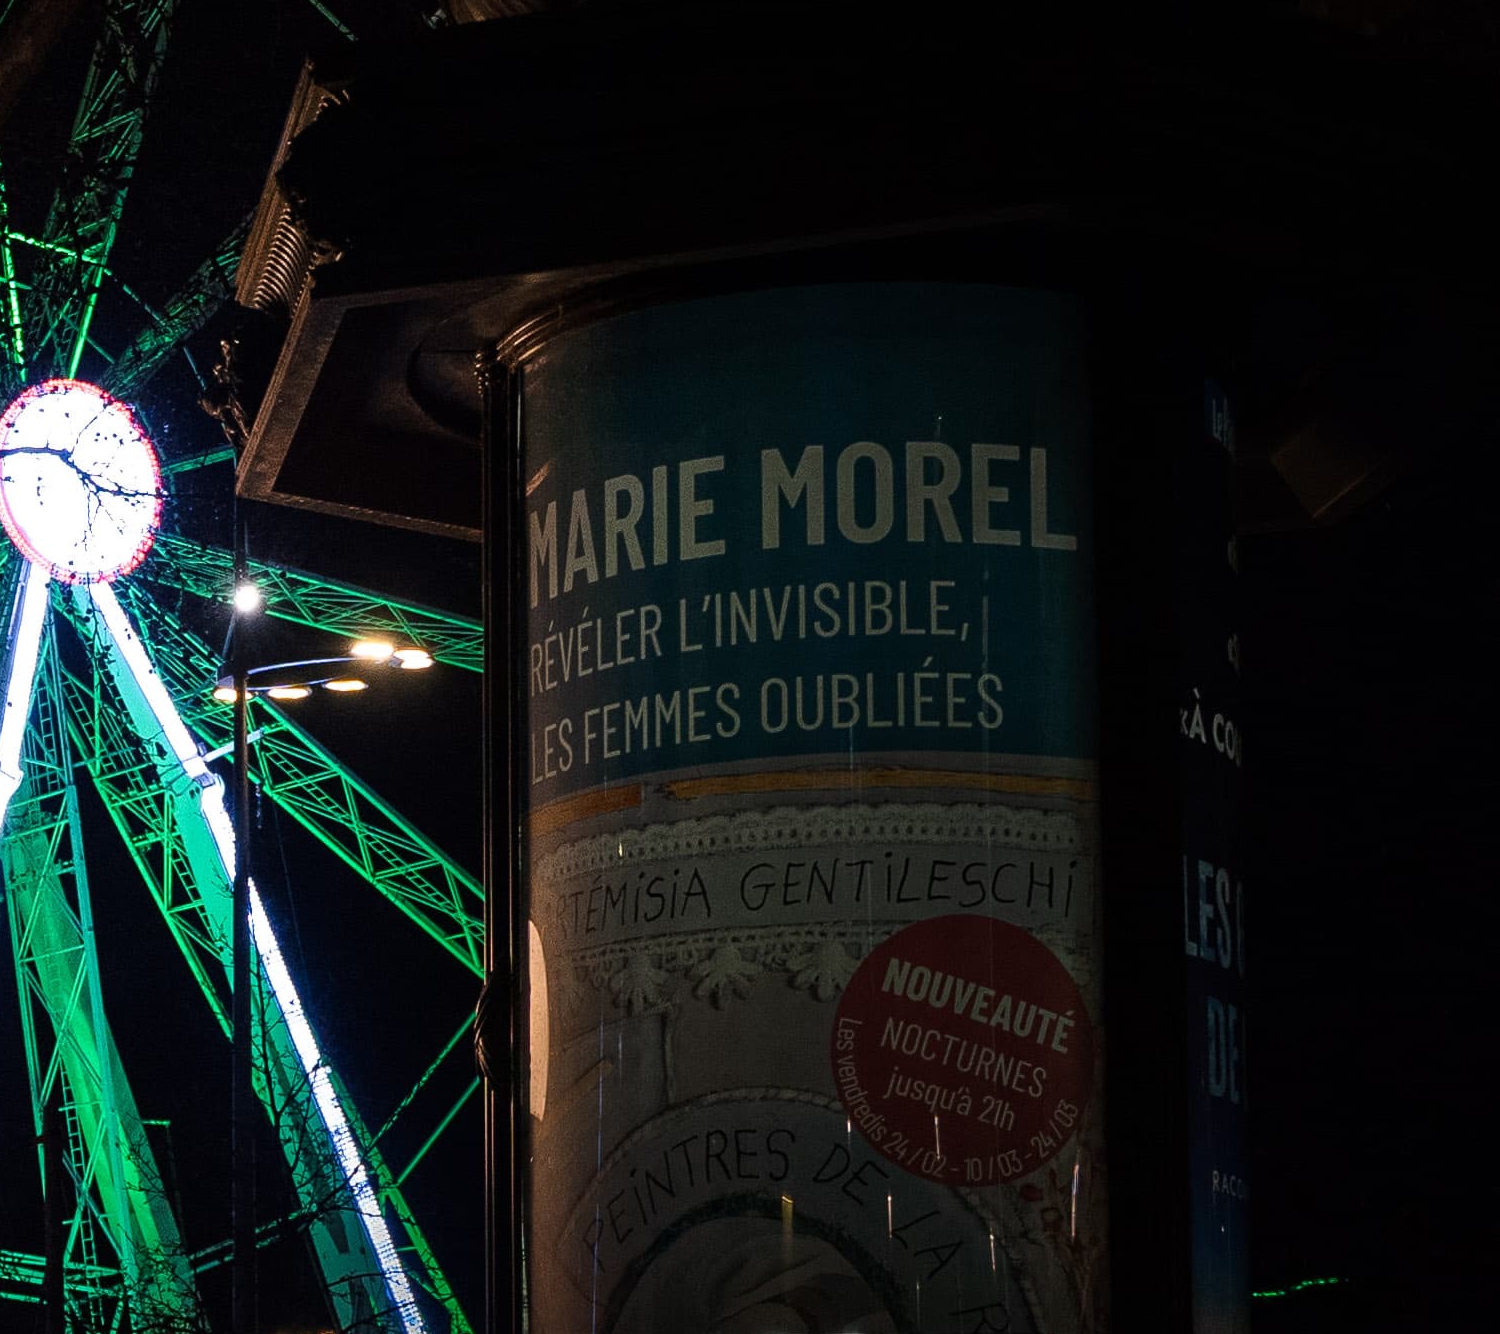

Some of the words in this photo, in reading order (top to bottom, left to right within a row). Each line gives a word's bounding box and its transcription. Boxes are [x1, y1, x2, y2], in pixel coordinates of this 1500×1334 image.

[528, 455, 727, 609] MARIE
[761, 440, 1077, 552] MOREL
[531, 603, 663, 699] RÉVÉLER
[679, 579, 970, 652] L'INVISIBLE,
[531, 718, 573, 786] LES
[584, 681, 741, 760] FEMMES
[761, 656, 1004, 732] OUBLIÉES
[544, 867, 711, 939] RTÉMISIA
[740, 852, 1078, 917] GENTILESCHI
[836, 1017, 863, 1051] Les
[881, 957, 1076, 1054] NOUVEAUTÉ
[837, 1054, 888, 1142] vendredis
[880, 1016, 1047, 1098] NOCTURNES
[883, 1066, 973, 1116] jusqu'à
[978, 1095, 1016, 1132] 21h
[583, 1128, 794, 1273] PEINTRES
[812, 1141, 890, 1207] DE
[889, 1209, 965, 1281] LA
